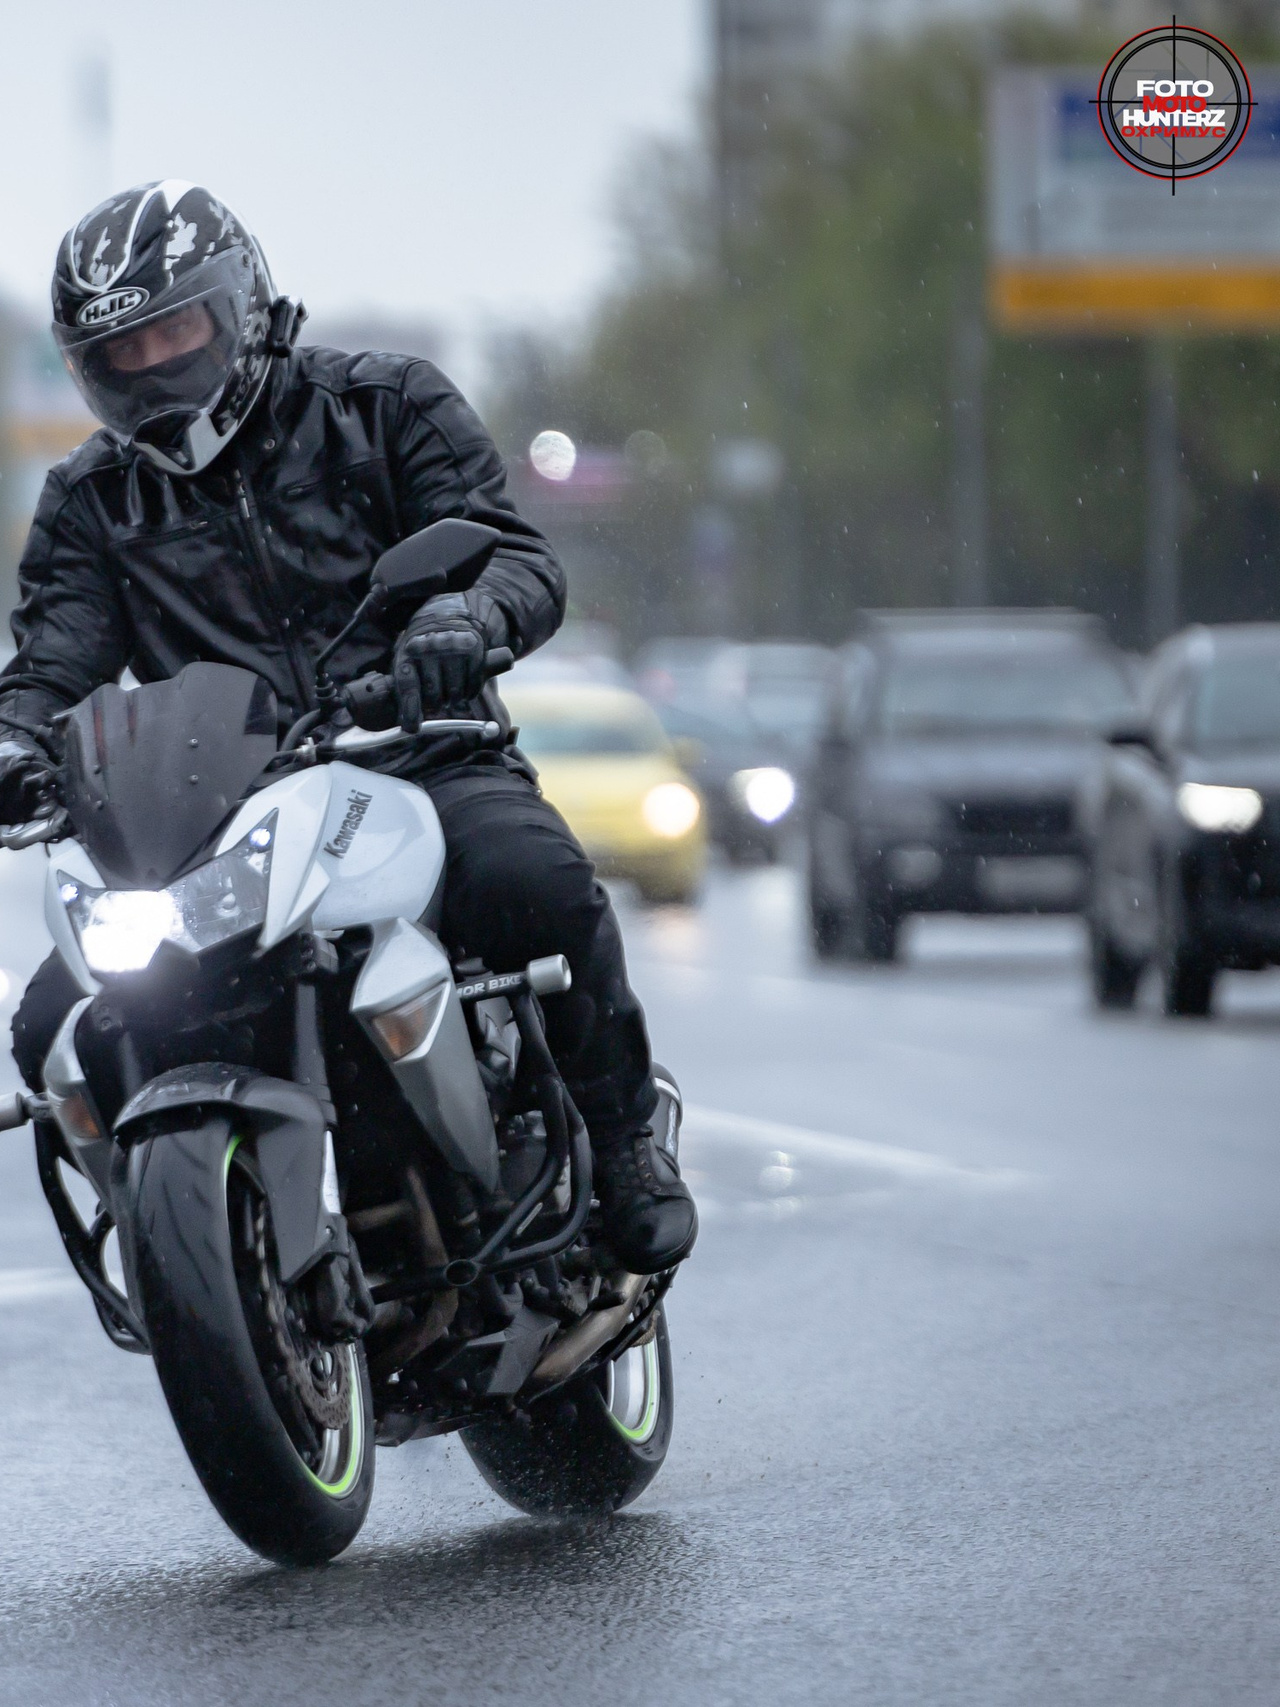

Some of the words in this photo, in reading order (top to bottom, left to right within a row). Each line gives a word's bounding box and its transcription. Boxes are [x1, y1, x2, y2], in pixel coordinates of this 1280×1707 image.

[85, 290, 136, 323] HJC
[323, 789, 373, 859] Kawasaki
[488, 974, 522, 990] BIKE
